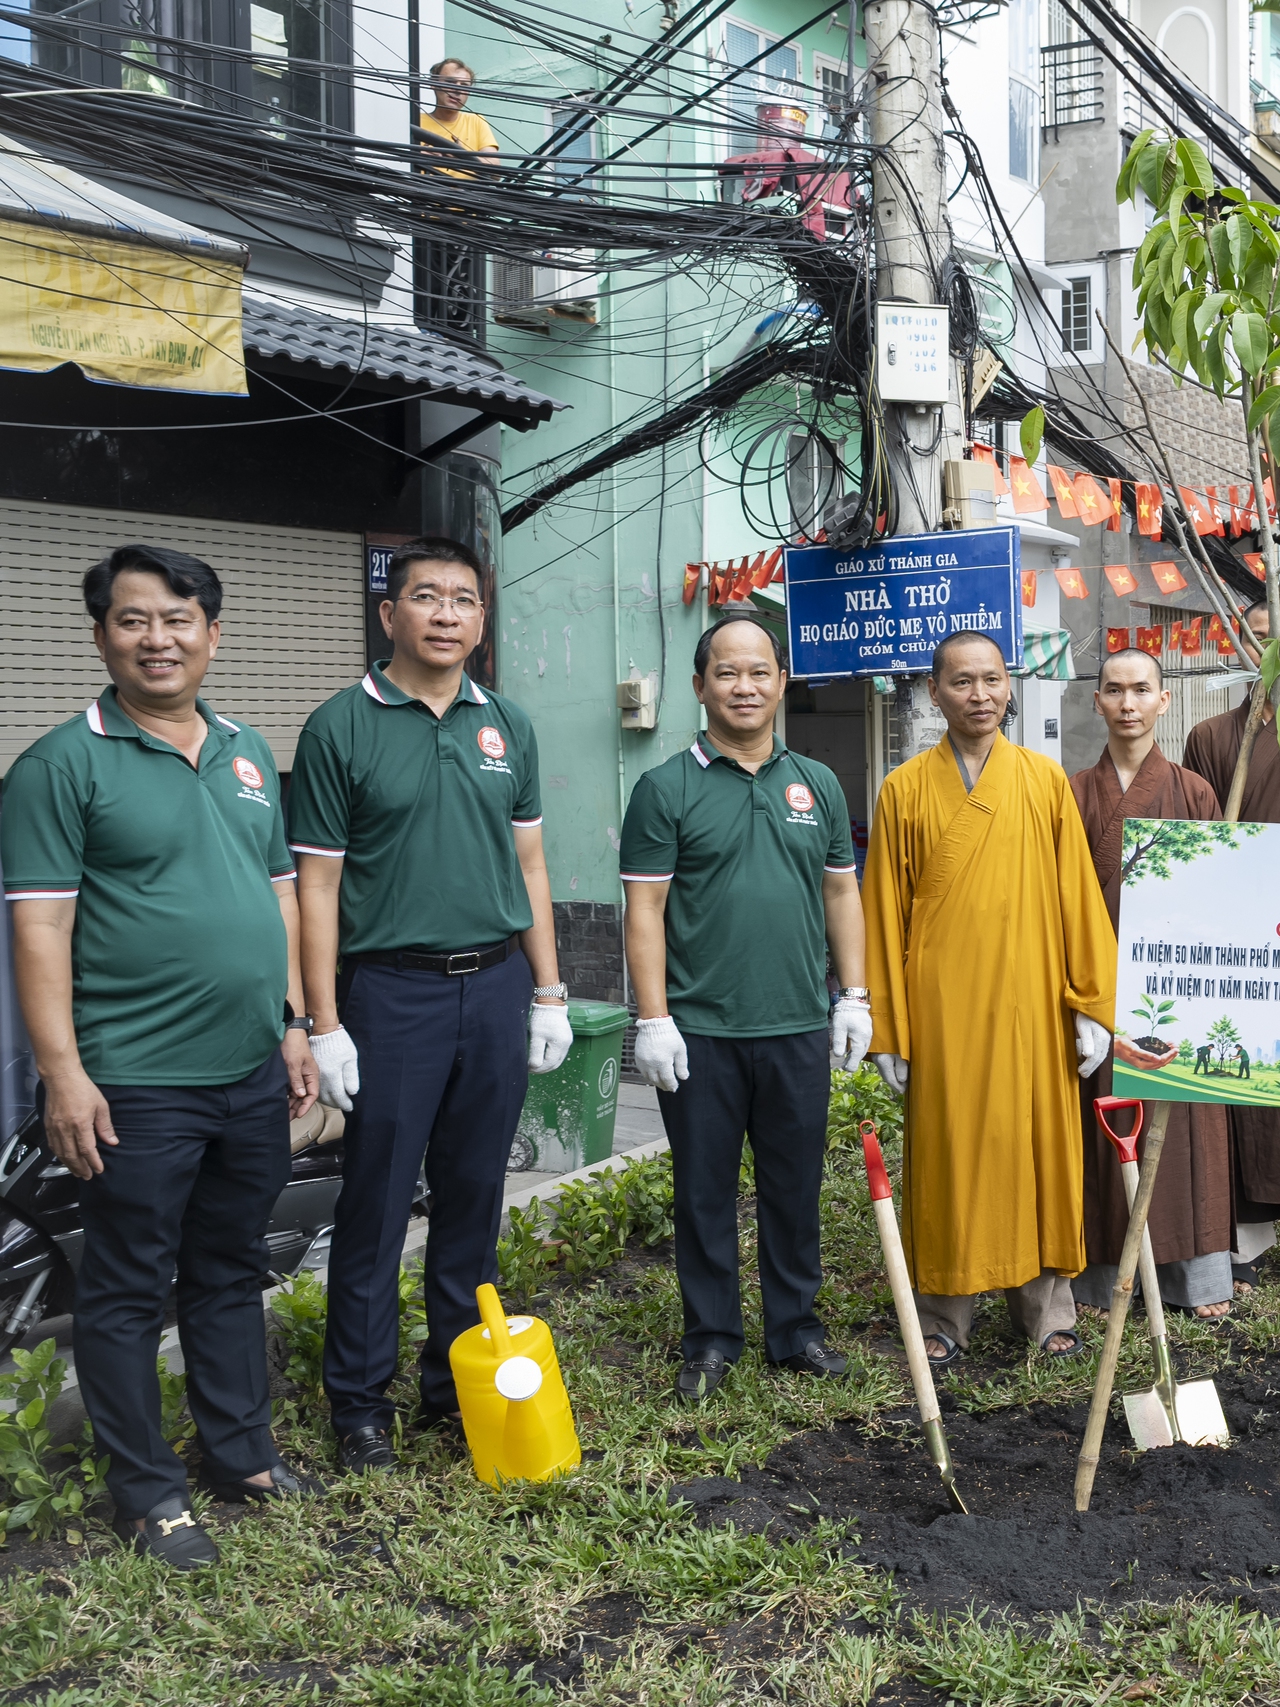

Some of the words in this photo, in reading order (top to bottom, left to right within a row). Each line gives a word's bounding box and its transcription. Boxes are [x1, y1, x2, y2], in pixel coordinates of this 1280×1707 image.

[835, 556, 864, 575] GIÁO
[868, 552, 885, 570] XỨ
[889, 551, 932, 570] THÁNH
[936, 553, 958, 566] GIA
[845, 582, 892, 612] NHÀ
[905, 576, 951, 608] THỜ
[800, 624, 820, 646] HỌ
[822, 617, 858, 642] GIÁO
[864, 614, 896, 639] ĐỨC
[900, 617, 922, 638] MẸ
[926, 610, 946, 634] VÔ
[951, 602, 1002, 631] NHIỄM
[859, 640, 893, 658] (XÓM
[892, 659, 908, 668] 50m
[1132, 937, 1145, 962] KỶ
[1148, 940, 1172, 968] NIỆM
[1175, 944, 1186, 964] 50
[1190, 942, 1212, 966] NĂM
[1216, 943, 1246, 967] THÀNH
[1250, 942, 1270, 969] PHỐ
[1146, 974, 1158, 995] VÀ
[1161, 970, 1174, 996] KỶ
[1177, 974, 1201, 1001] NIỆM
[1205, 978, 1215, 997] 01
[1219, 976, 1241, 999] NĂM
[1245, 978, 1270, 1000] NGÀY
